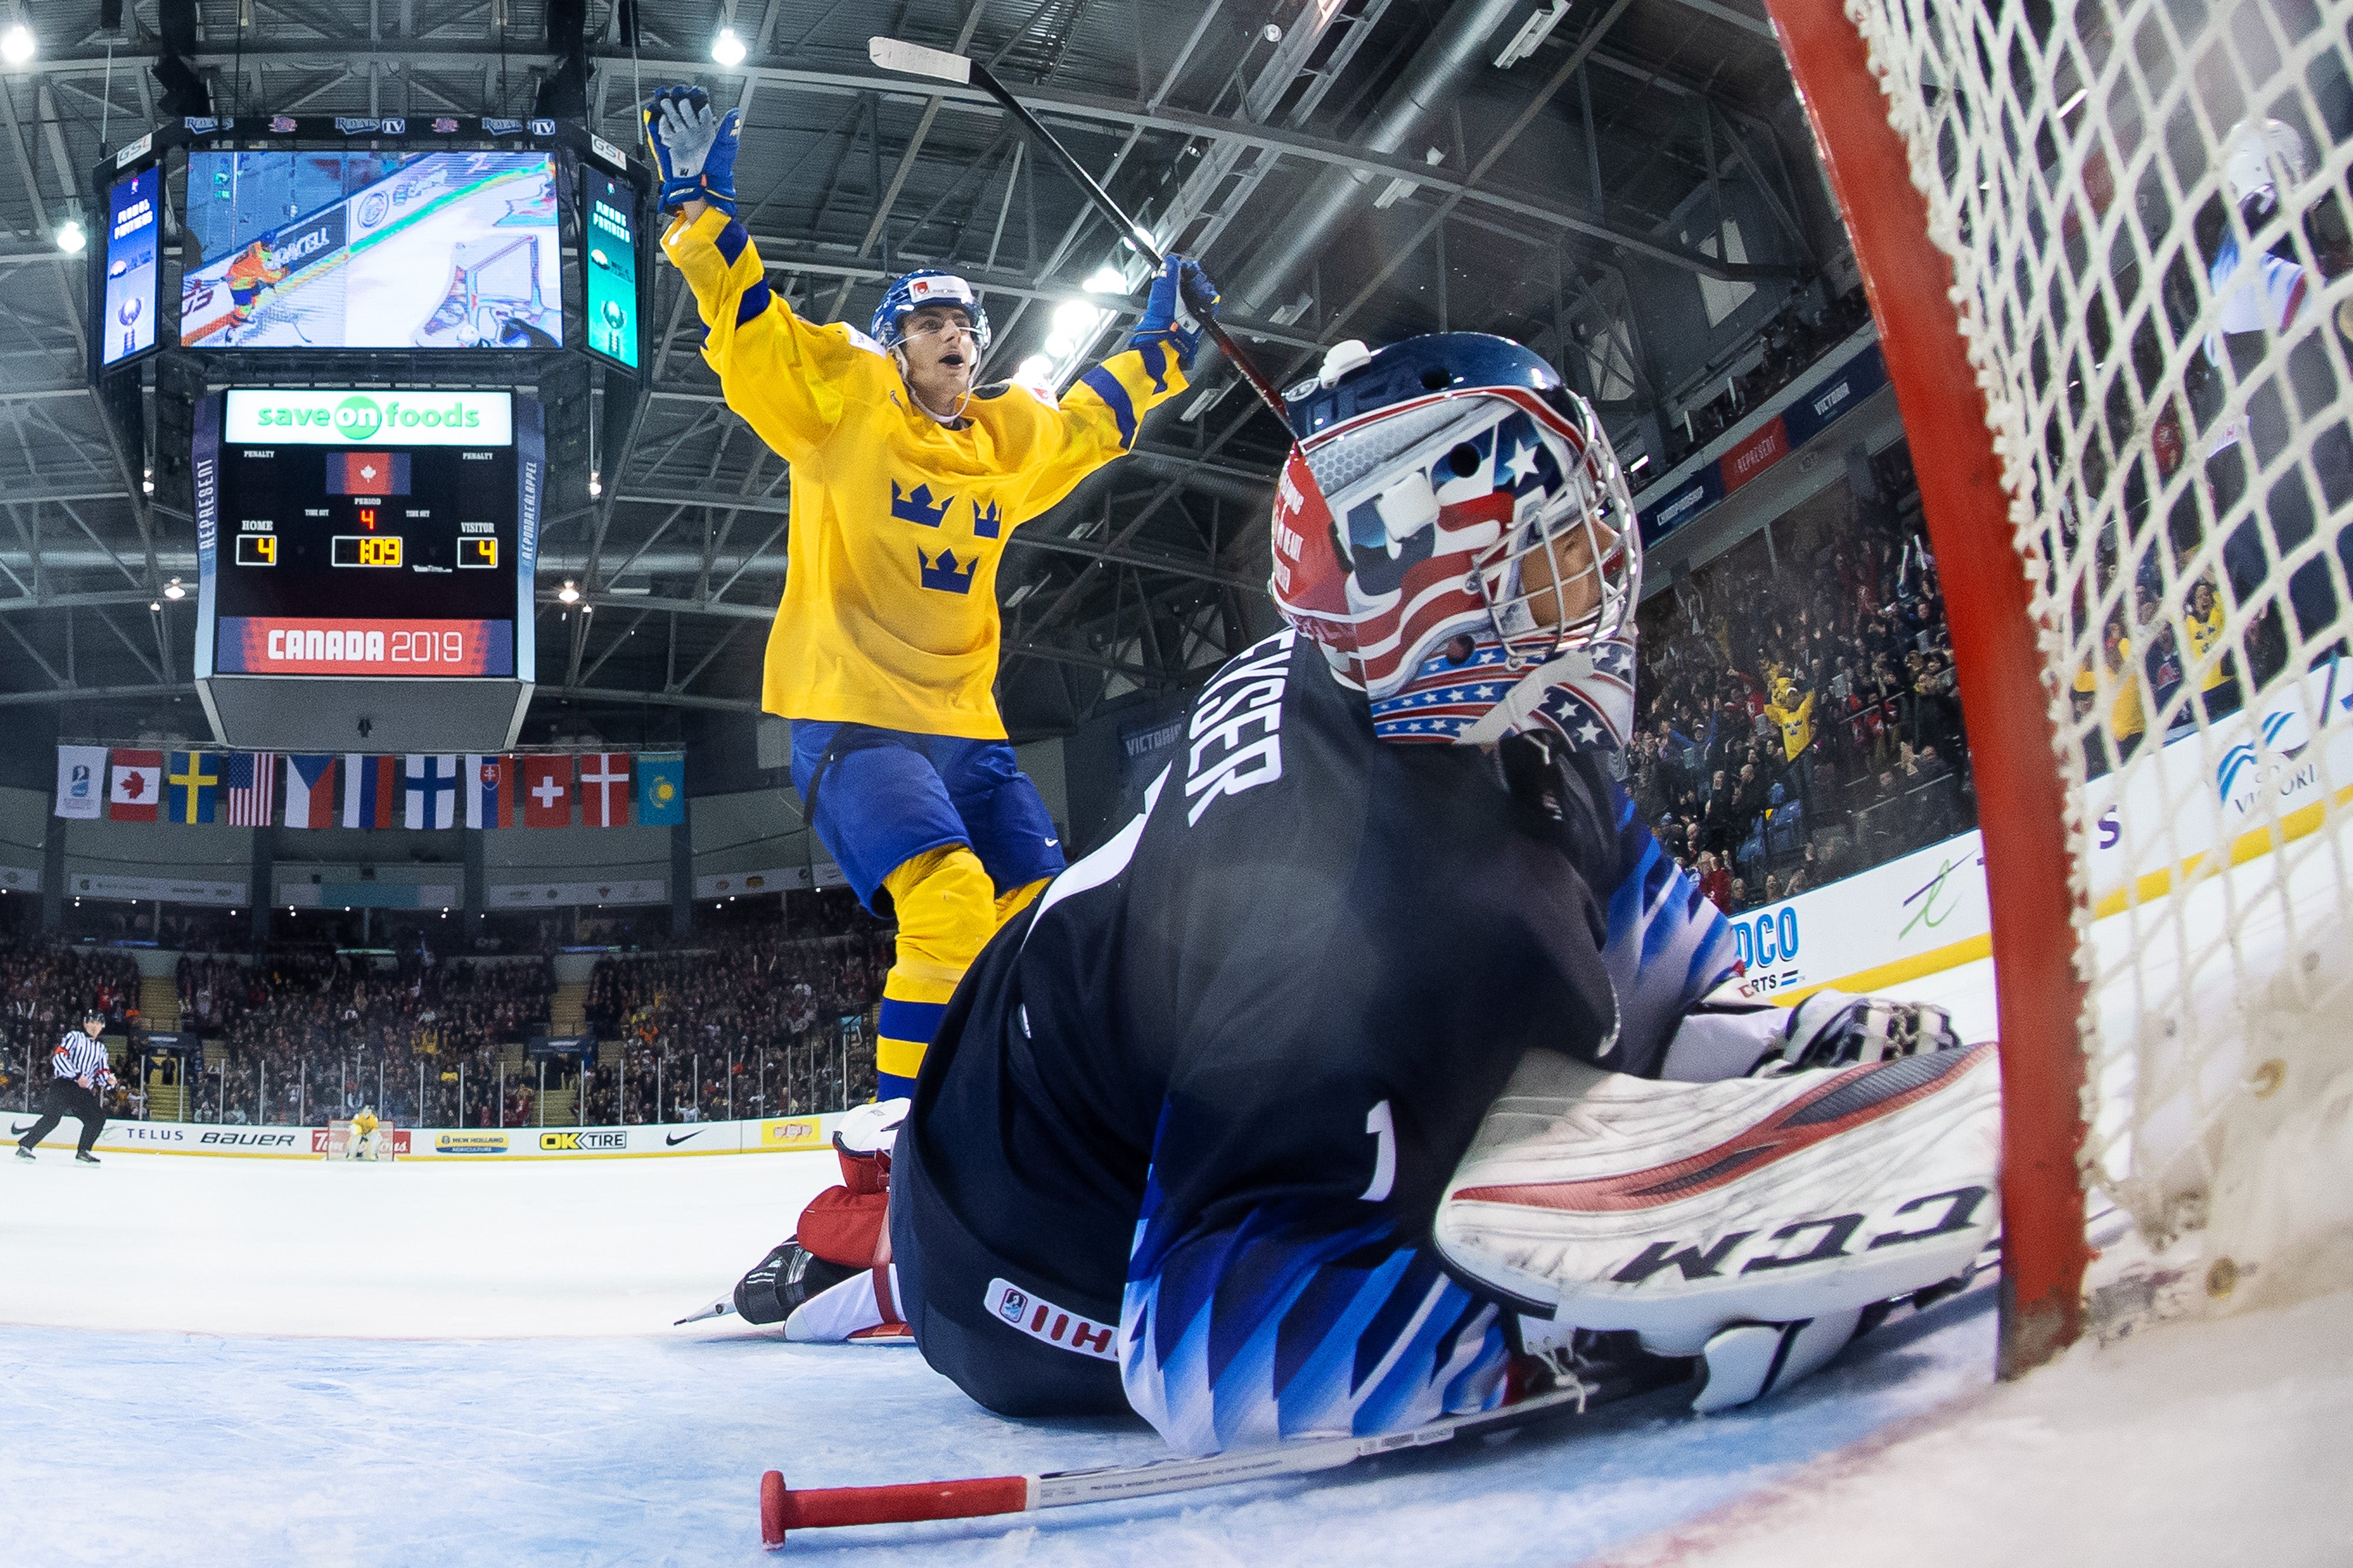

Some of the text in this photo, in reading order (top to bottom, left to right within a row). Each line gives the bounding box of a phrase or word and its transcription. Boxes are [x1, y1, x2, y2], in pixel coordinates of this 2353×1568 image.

[383, 119, 404, 133] TV
[533, 119, 555, 135] TV
[594, 138, 625, 164] GSL
[258, 402, 479, 428] save on foods
[197, 459, 215, 550] REPRESENT
[242, 520, 273, 531] HOME
[361, 509, 375, 530] 4
[461, 522, 495, 533] VISITOR
[257, 537, 275, 563] 4
[359, 538, 401, 565] 1:09
[478, 539, 496, 566] 4
[268, 629, 463, 662] CANADA 2019
[1184, 625, 1297, 828] EYSER
[1733, 906, 1799, 969] DCO
[1751, 974, 1777, 992] RTS
[127, 1128, 184, 1141] TELUS
[540, 1133, 624, 1150] OK TIRE
[1357, 1099, 1397, 1202] 1
[1610, 1185, 1988, 1282] CCM
[1031, 1305, 1119, 1357] IIH
